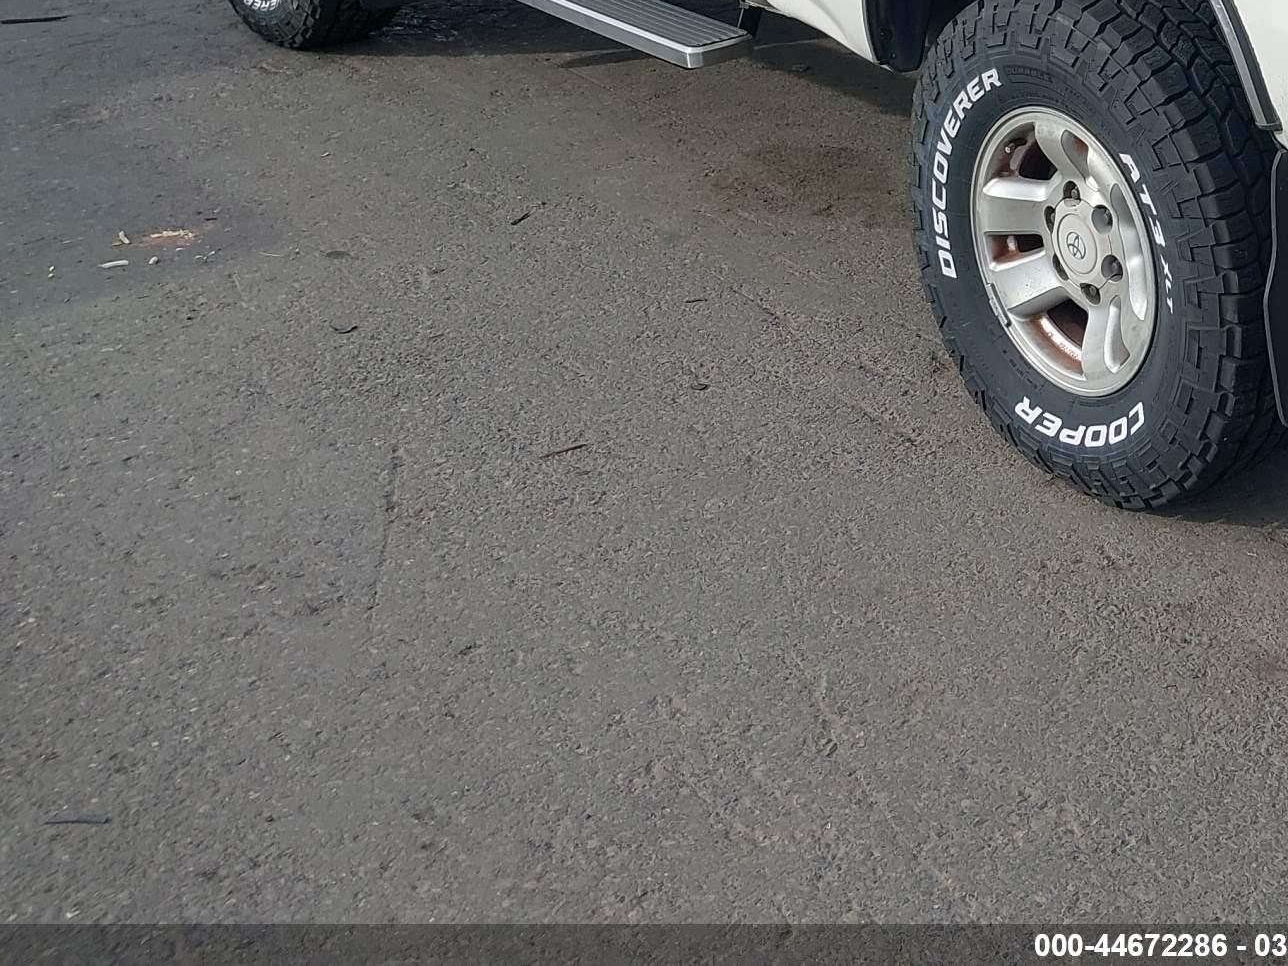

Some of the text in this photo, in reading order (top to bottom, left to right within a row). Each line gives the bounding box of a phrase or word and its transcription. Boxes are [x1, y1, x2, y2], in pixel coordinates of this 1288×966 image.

[931, 68, 1002, 278] DISCOVERER
[1119, 153, 1166, 247] AT3
[1014, 396, 1145, 447] COOPER
